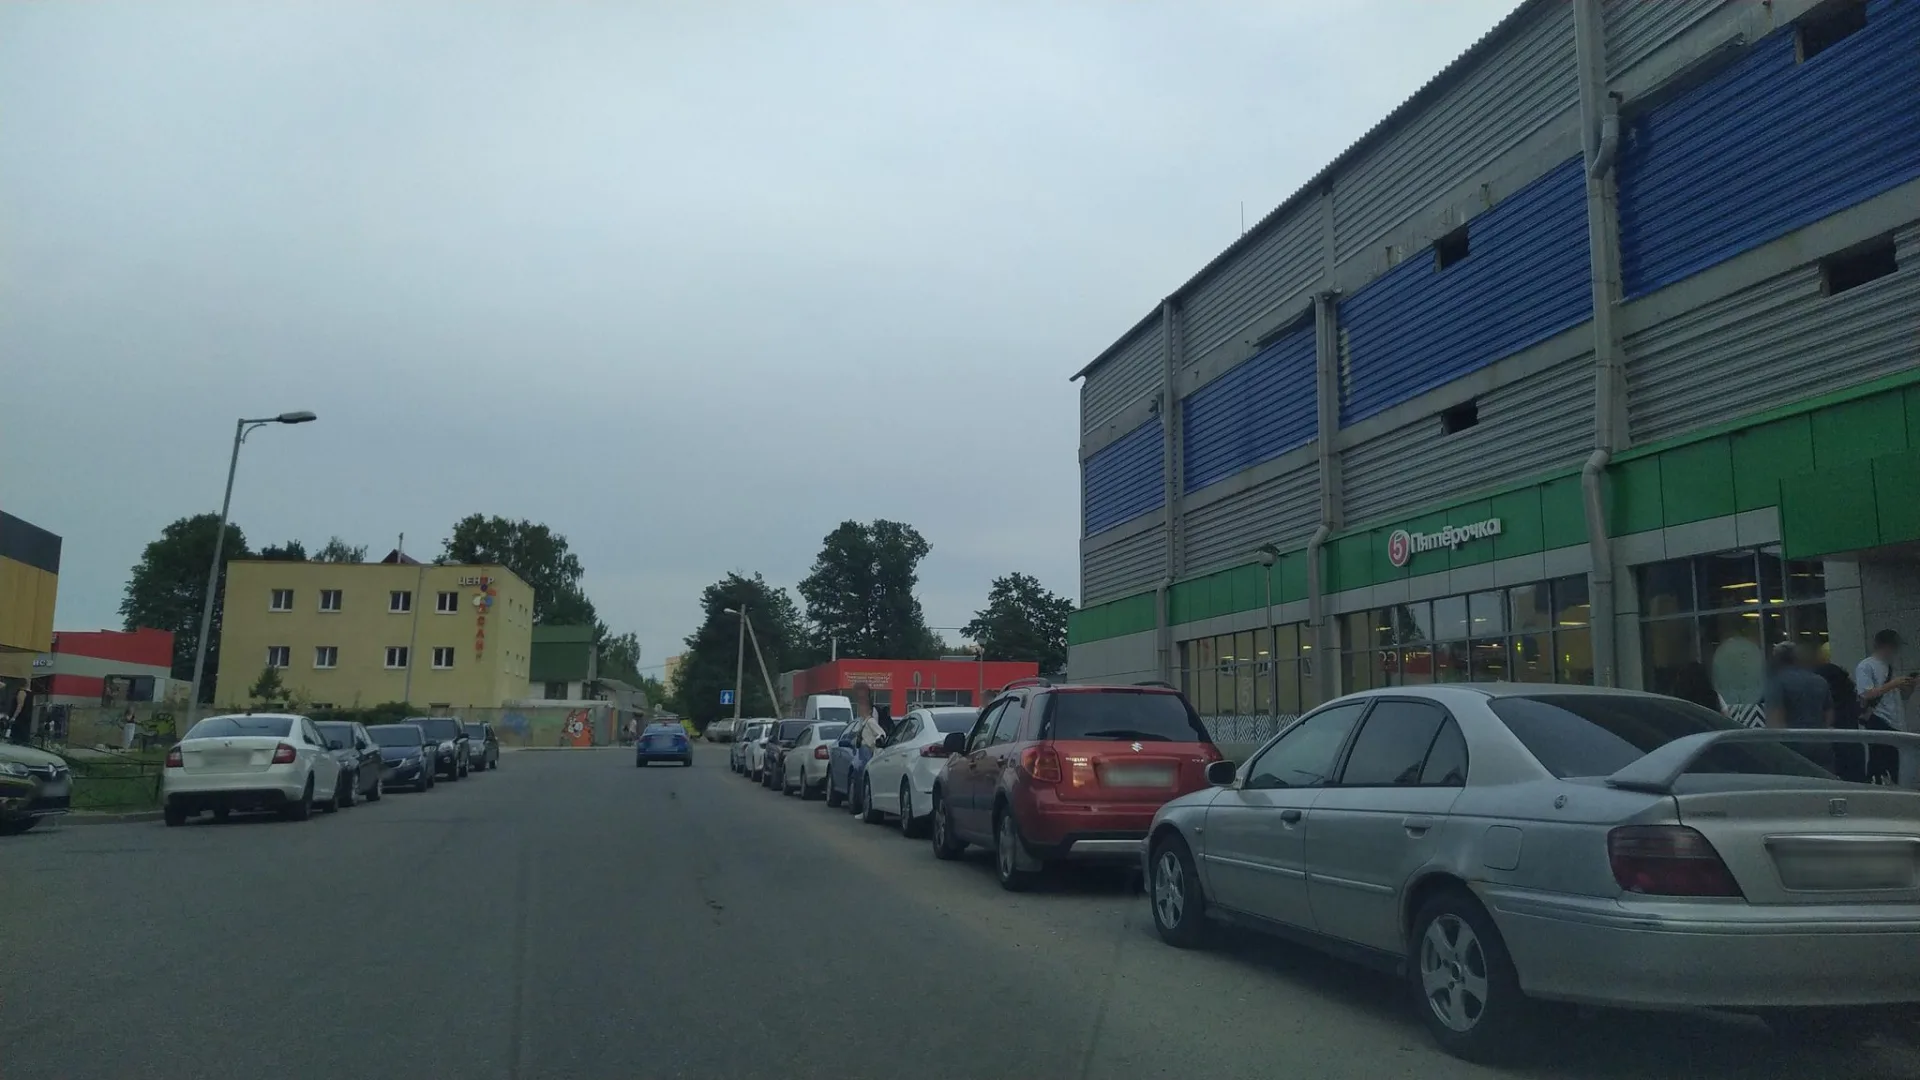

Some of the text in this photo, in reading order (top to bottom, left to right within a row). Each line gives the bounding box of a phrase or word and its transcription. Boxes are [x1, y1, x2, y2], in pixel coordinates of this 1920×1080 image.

[1393, 518, 1501, 561] 5 Пятёрочка
[458, 576, 494, 586] ЦЕНР
